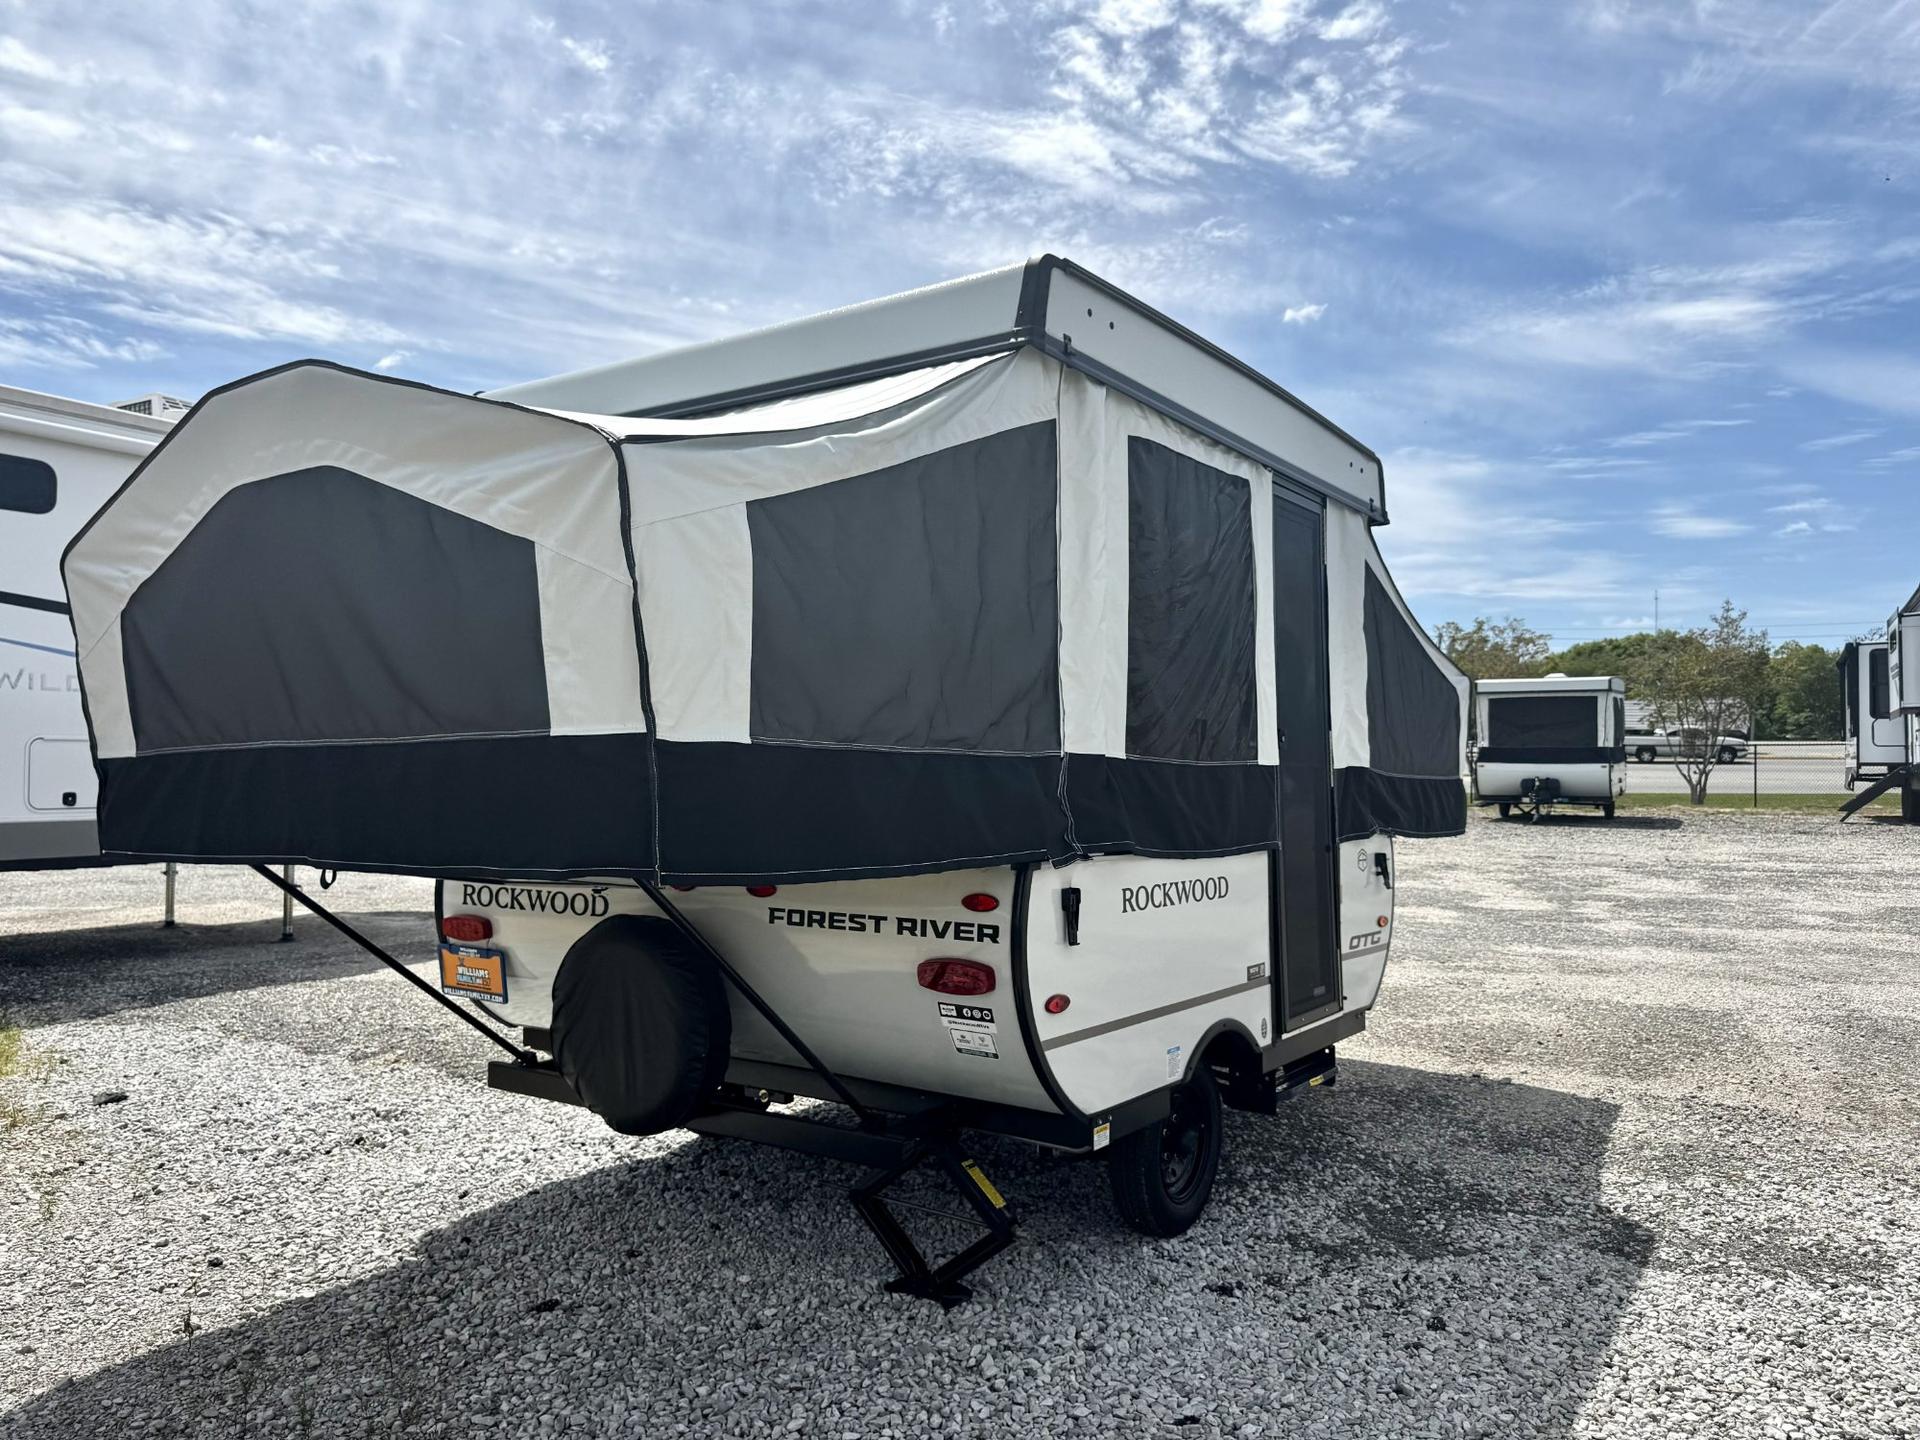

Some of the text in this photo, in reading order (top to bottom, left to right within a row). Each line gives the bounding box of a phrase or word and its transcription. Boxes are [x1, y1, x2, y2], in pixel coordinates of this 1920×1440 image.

[462, 884, 610, 917] ROCKWOOD
[1121, 876, 1229, 913] ROCKWOOD
[768, 907, 1000, 944] FOREST RIVER
